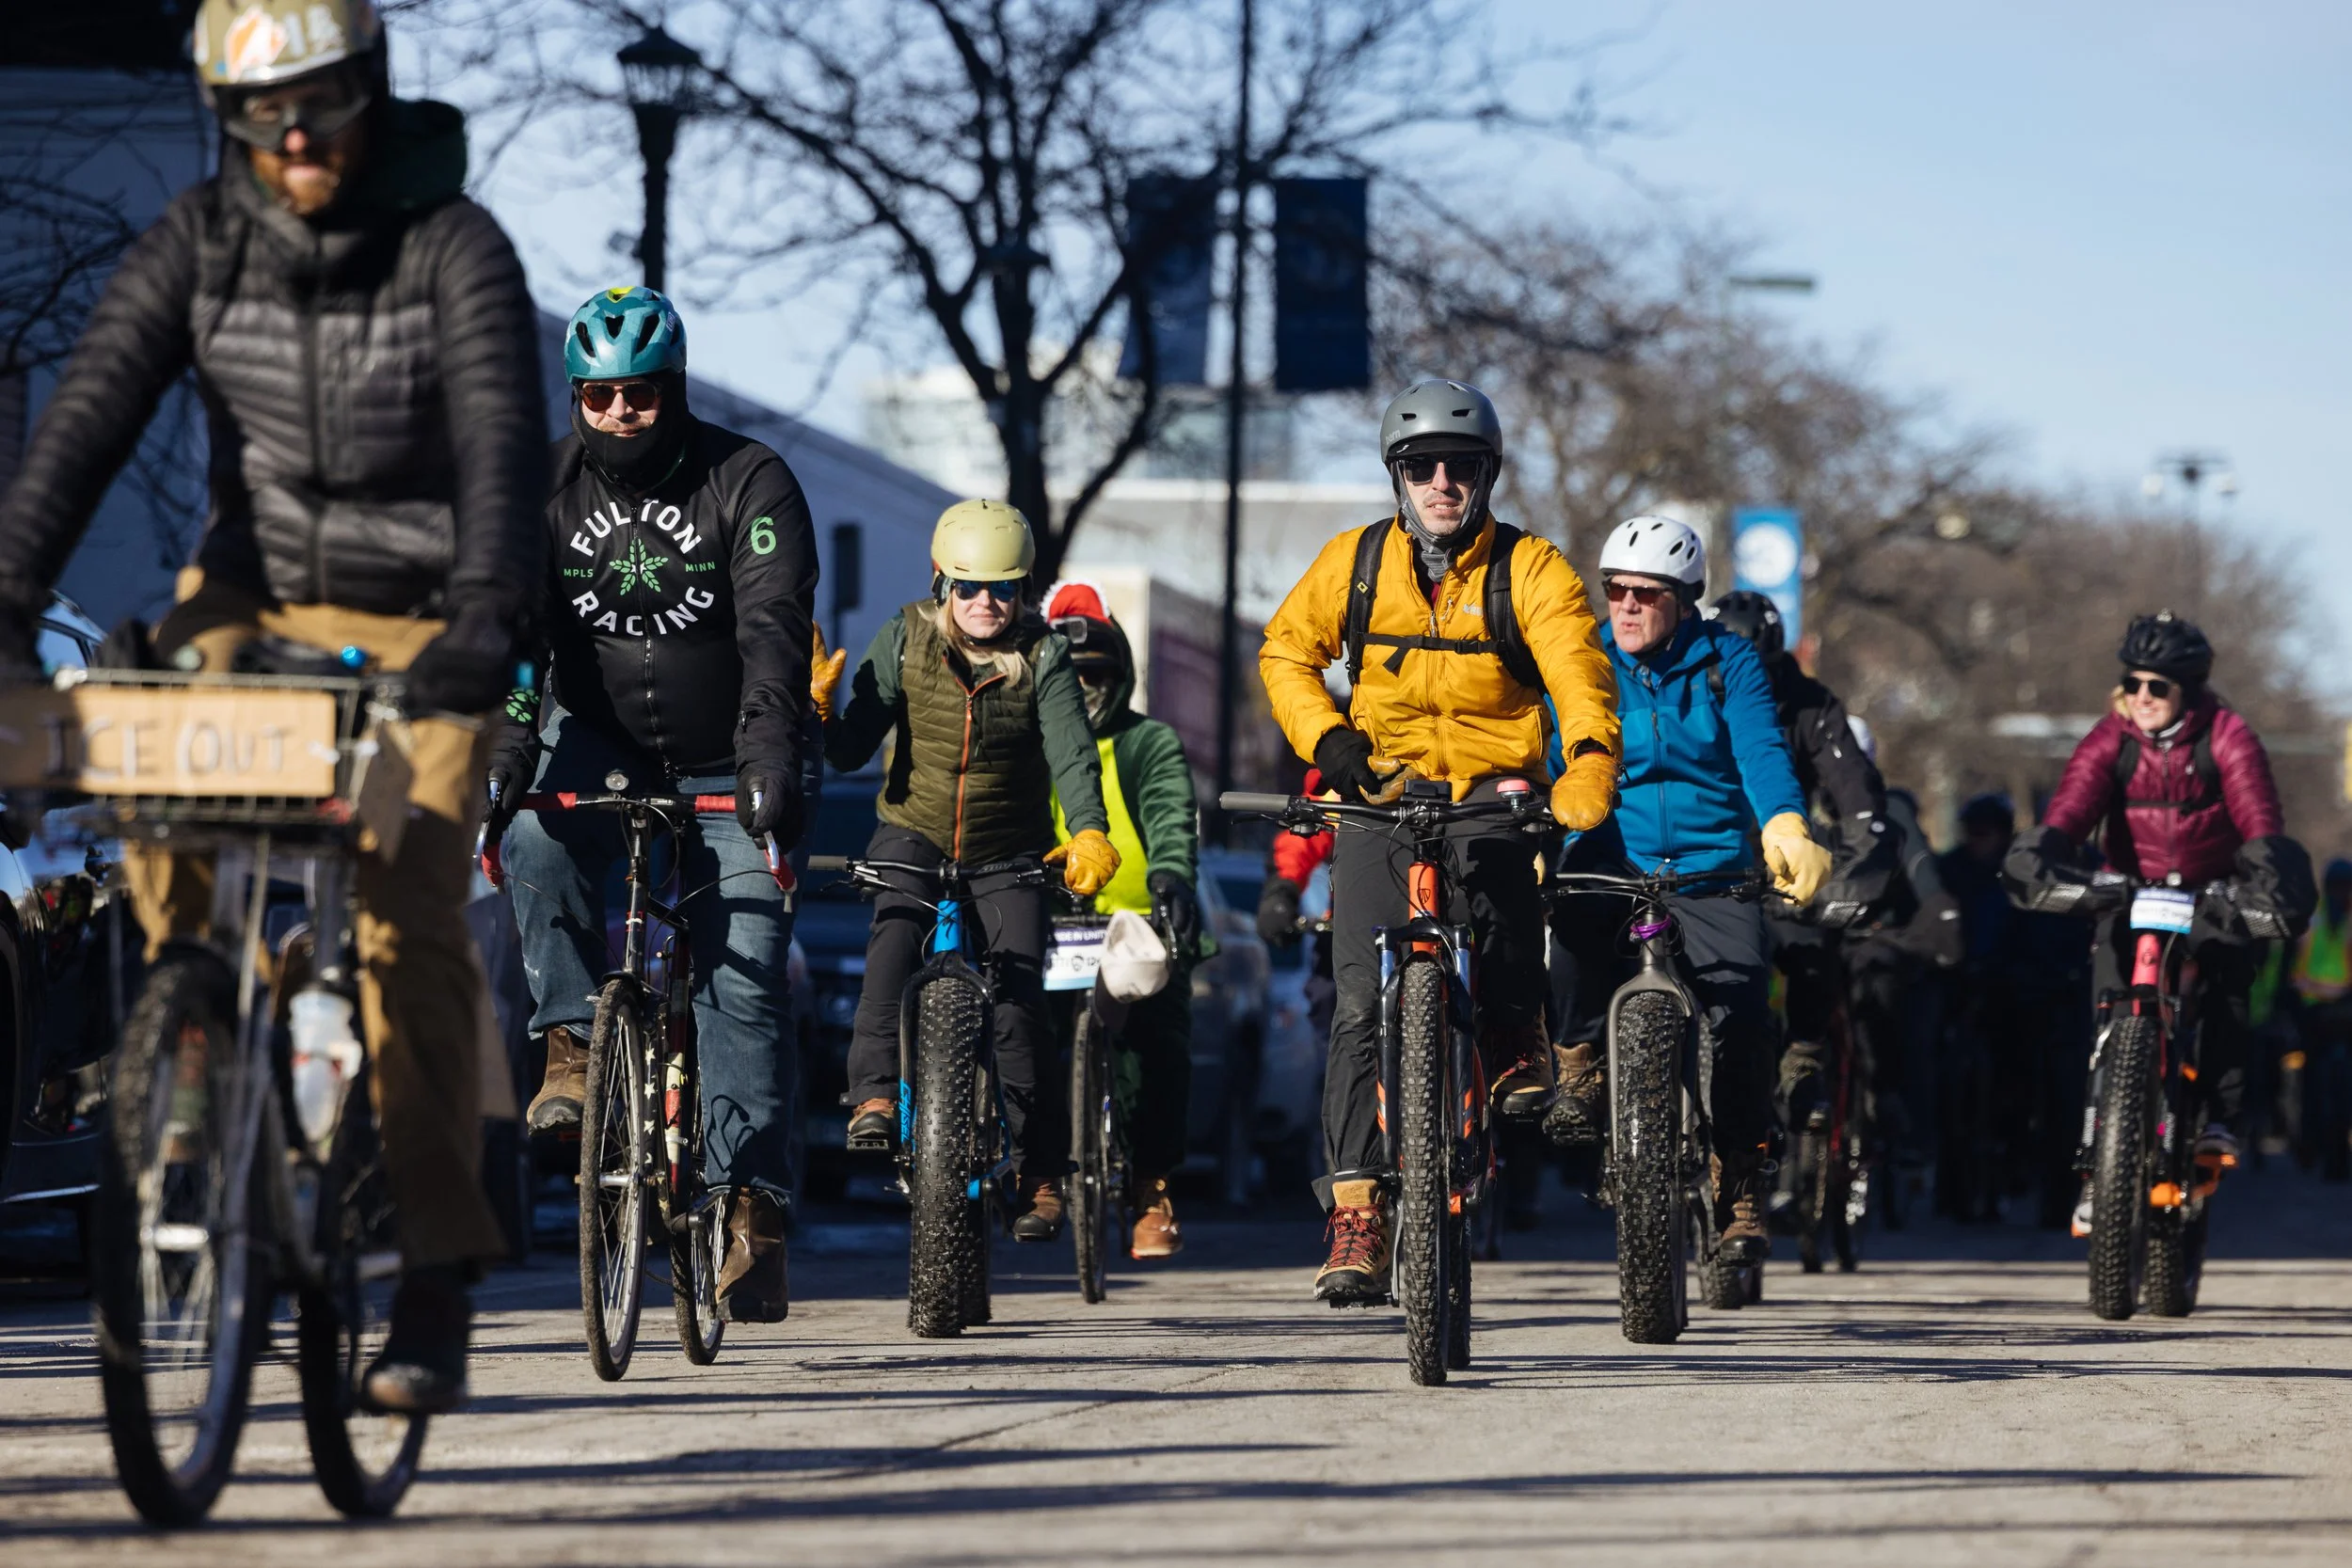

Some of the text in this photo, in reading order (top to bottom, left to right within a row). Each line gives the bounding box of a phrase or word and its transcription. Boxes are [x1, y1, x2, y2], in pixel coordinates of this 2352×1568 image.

[570, 499, 702, 557] FULTON
[750, 515, 777, 555] 6
[564, 561, 716, 578] MPLS MINN
[572, 586, 714, 636] RACING
[42, 712, 294, 781] ICE OUT
[898, 1077, 912, 1144] CHISEL
